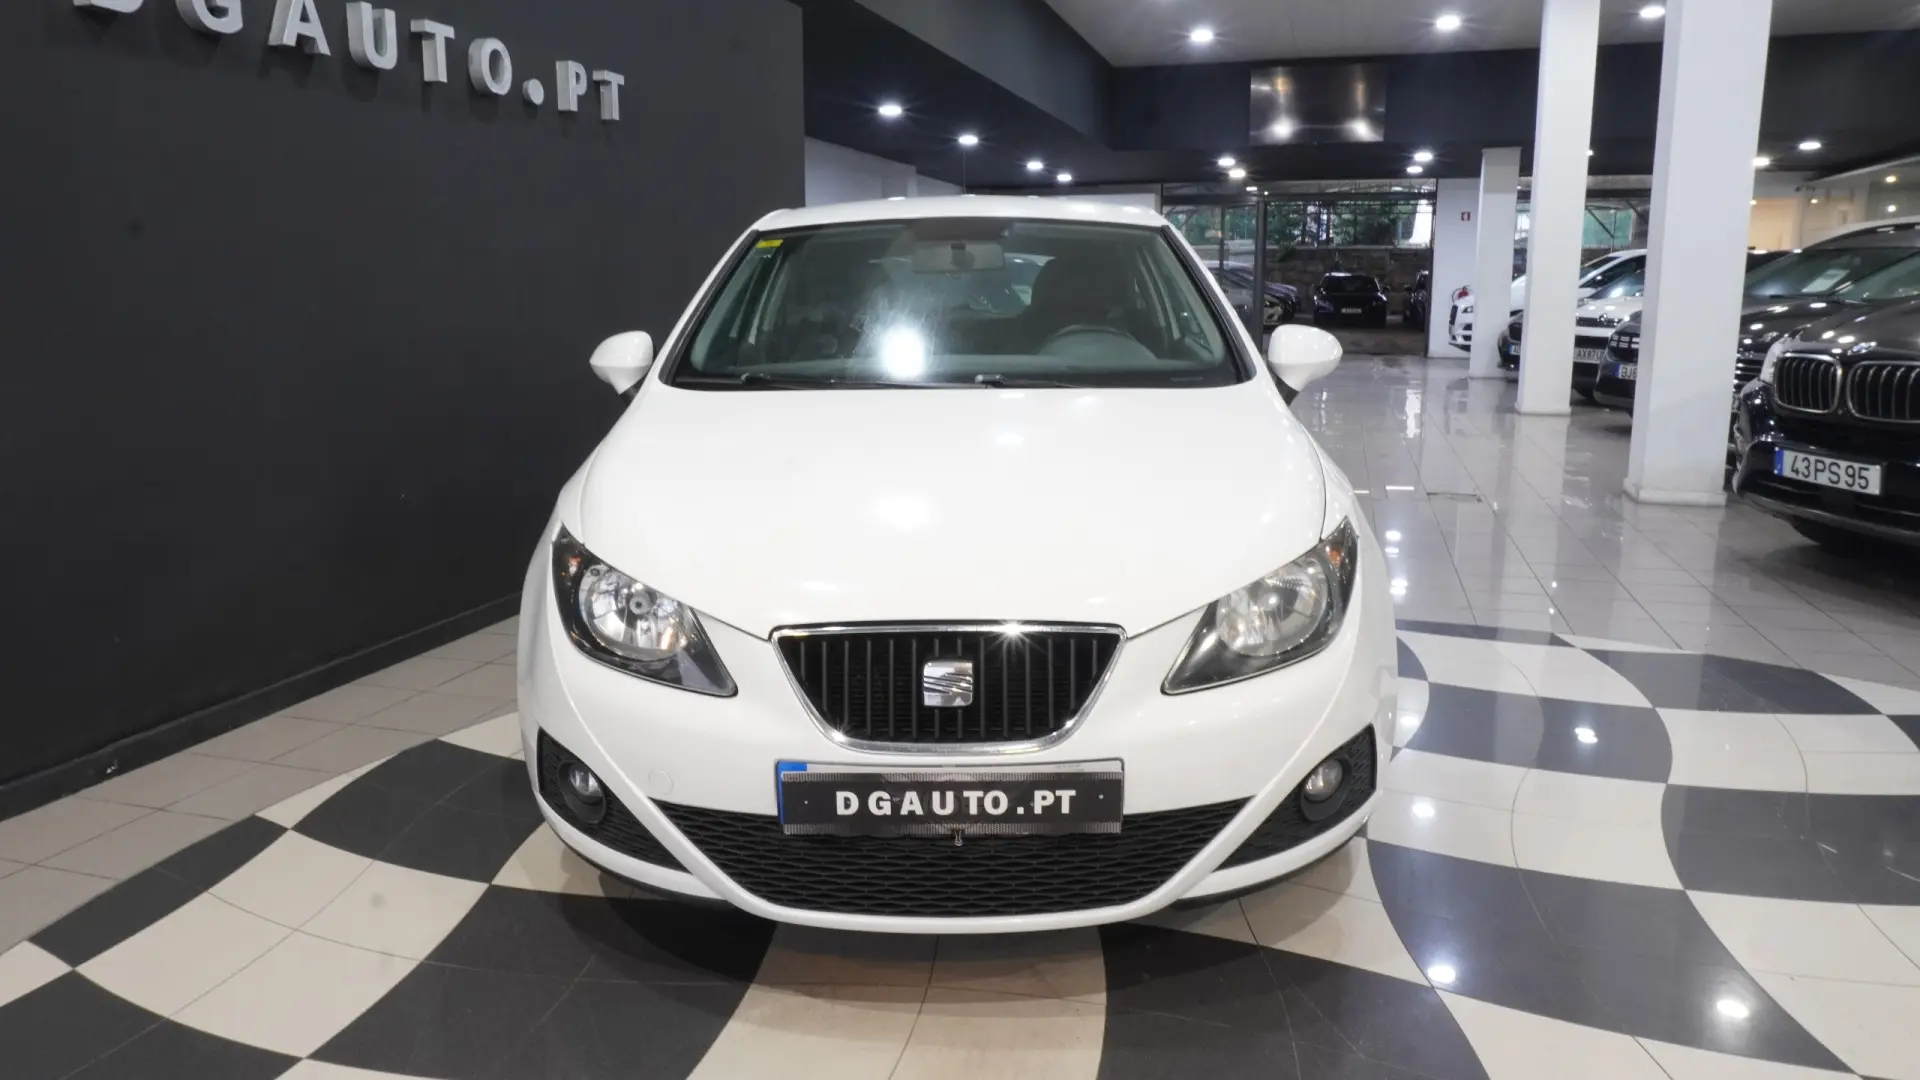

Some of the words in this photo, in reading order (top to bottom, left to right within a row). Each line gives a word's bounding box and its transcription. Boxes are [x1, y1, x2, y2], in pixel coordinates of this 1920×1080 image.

[73, 0, 625, 121] AUTO.PT
[1790, 454, 1870, 490] 43PS95
[835, 790, 1076, 816] DGAUTO.PT
